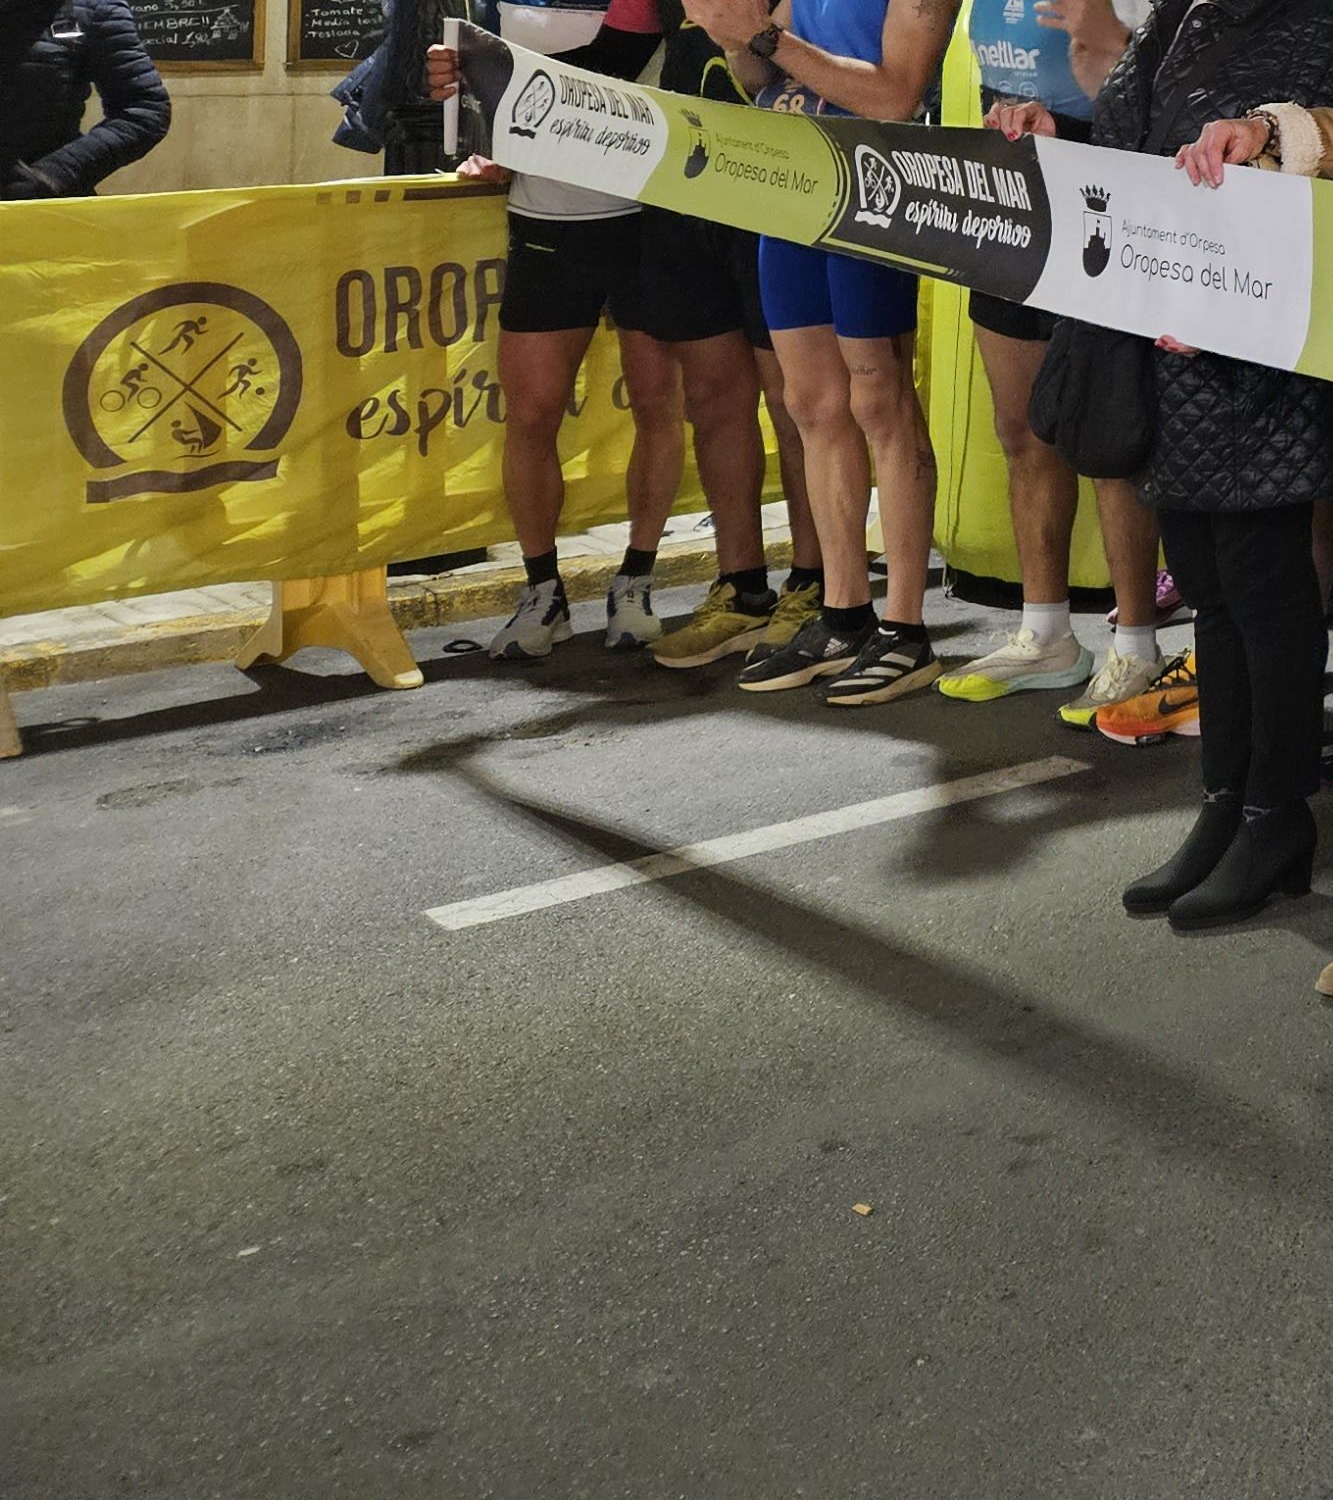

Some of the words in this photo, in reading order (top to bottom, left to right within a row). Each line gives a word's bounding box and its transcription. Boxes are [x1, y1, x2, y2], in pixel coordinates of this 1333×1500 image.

[559, 73, 607, 111] OROPESA
[602, 85, 630, 120] DEL
[630, 93, 656, 126] MAR
[714, 152, 768, 186] Oropesa
[769, 163, 790, 189] del
[791, 170, 818, 195] Mar
[890, 149, 966, 198] OROPESA
[962, 158, 996, 205] DEL
[992, 168, 1033, 212] MAR
[1120, 218, 1178, 246] Ajuntament
[1120, 243, 1194, 285] Oropesa
[1200, 262, 1228, 292] del
[1233, 268, 1273, 300] Mar
